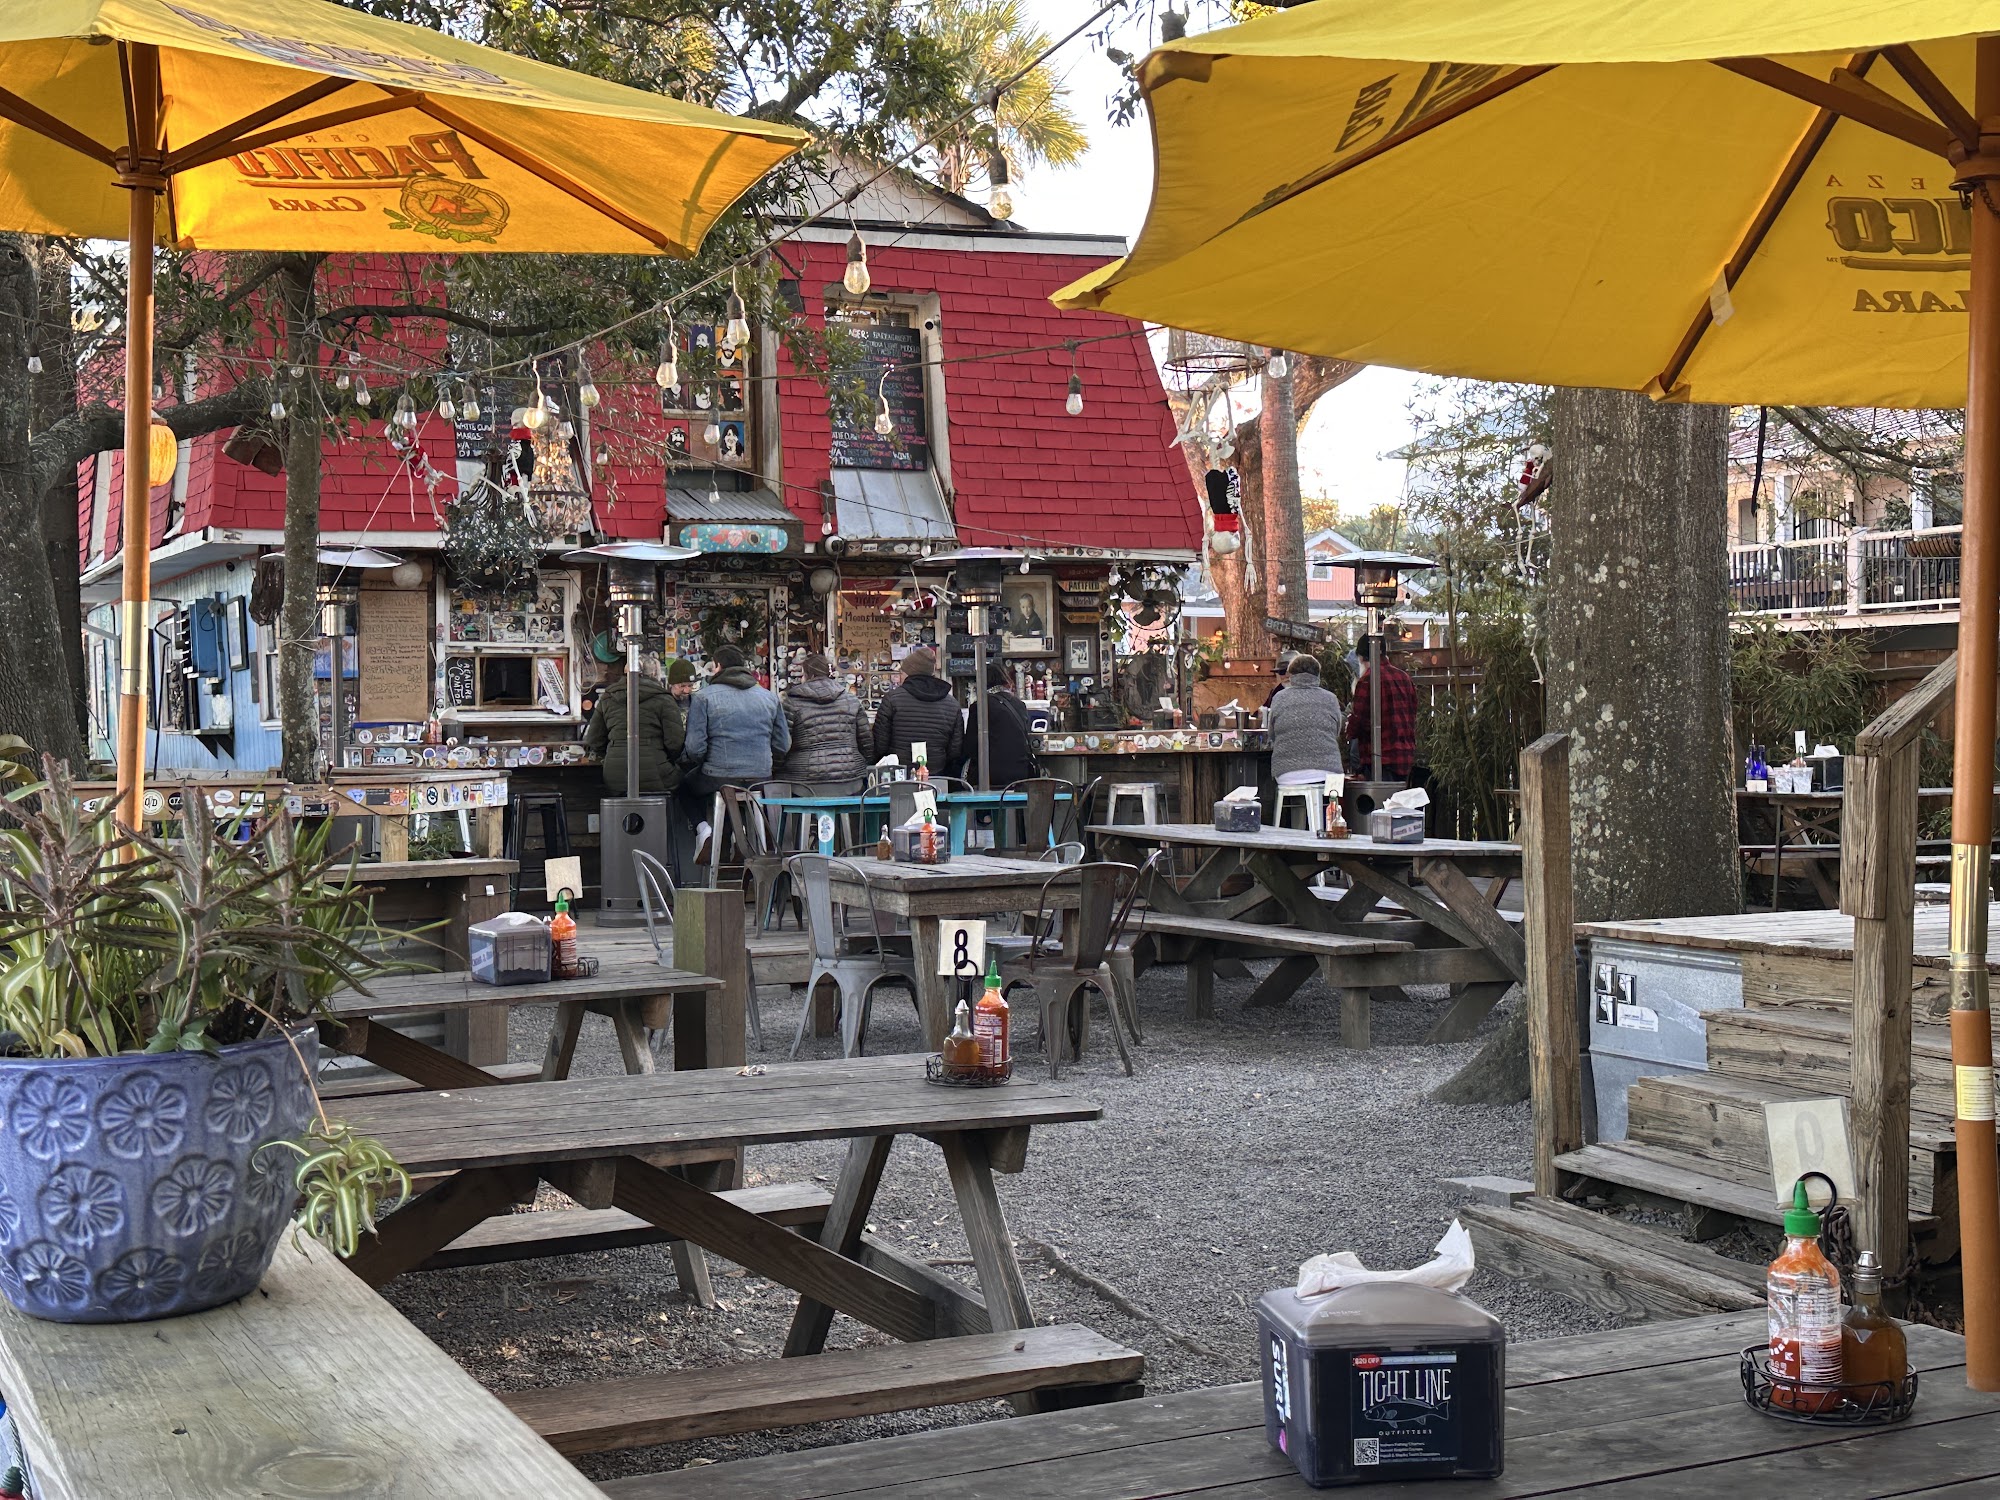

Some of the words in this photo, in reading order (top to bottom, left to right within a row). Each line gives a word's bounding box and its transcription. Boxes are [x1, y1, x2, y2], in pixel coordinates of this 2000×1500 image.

[448, 666, 465, 707] COMFOR
[953, 929, 968, 969] 8
[1272, 1339, 1285, 1422] SURF
[1367, 1357, 1379, 1365] OFF
[1359, 1371, 1410, 1411] TIGHT
[1415, 1368, 1451, 1409] LINE
[1378, 1428, 1432, 1436] OUTFITTERS
